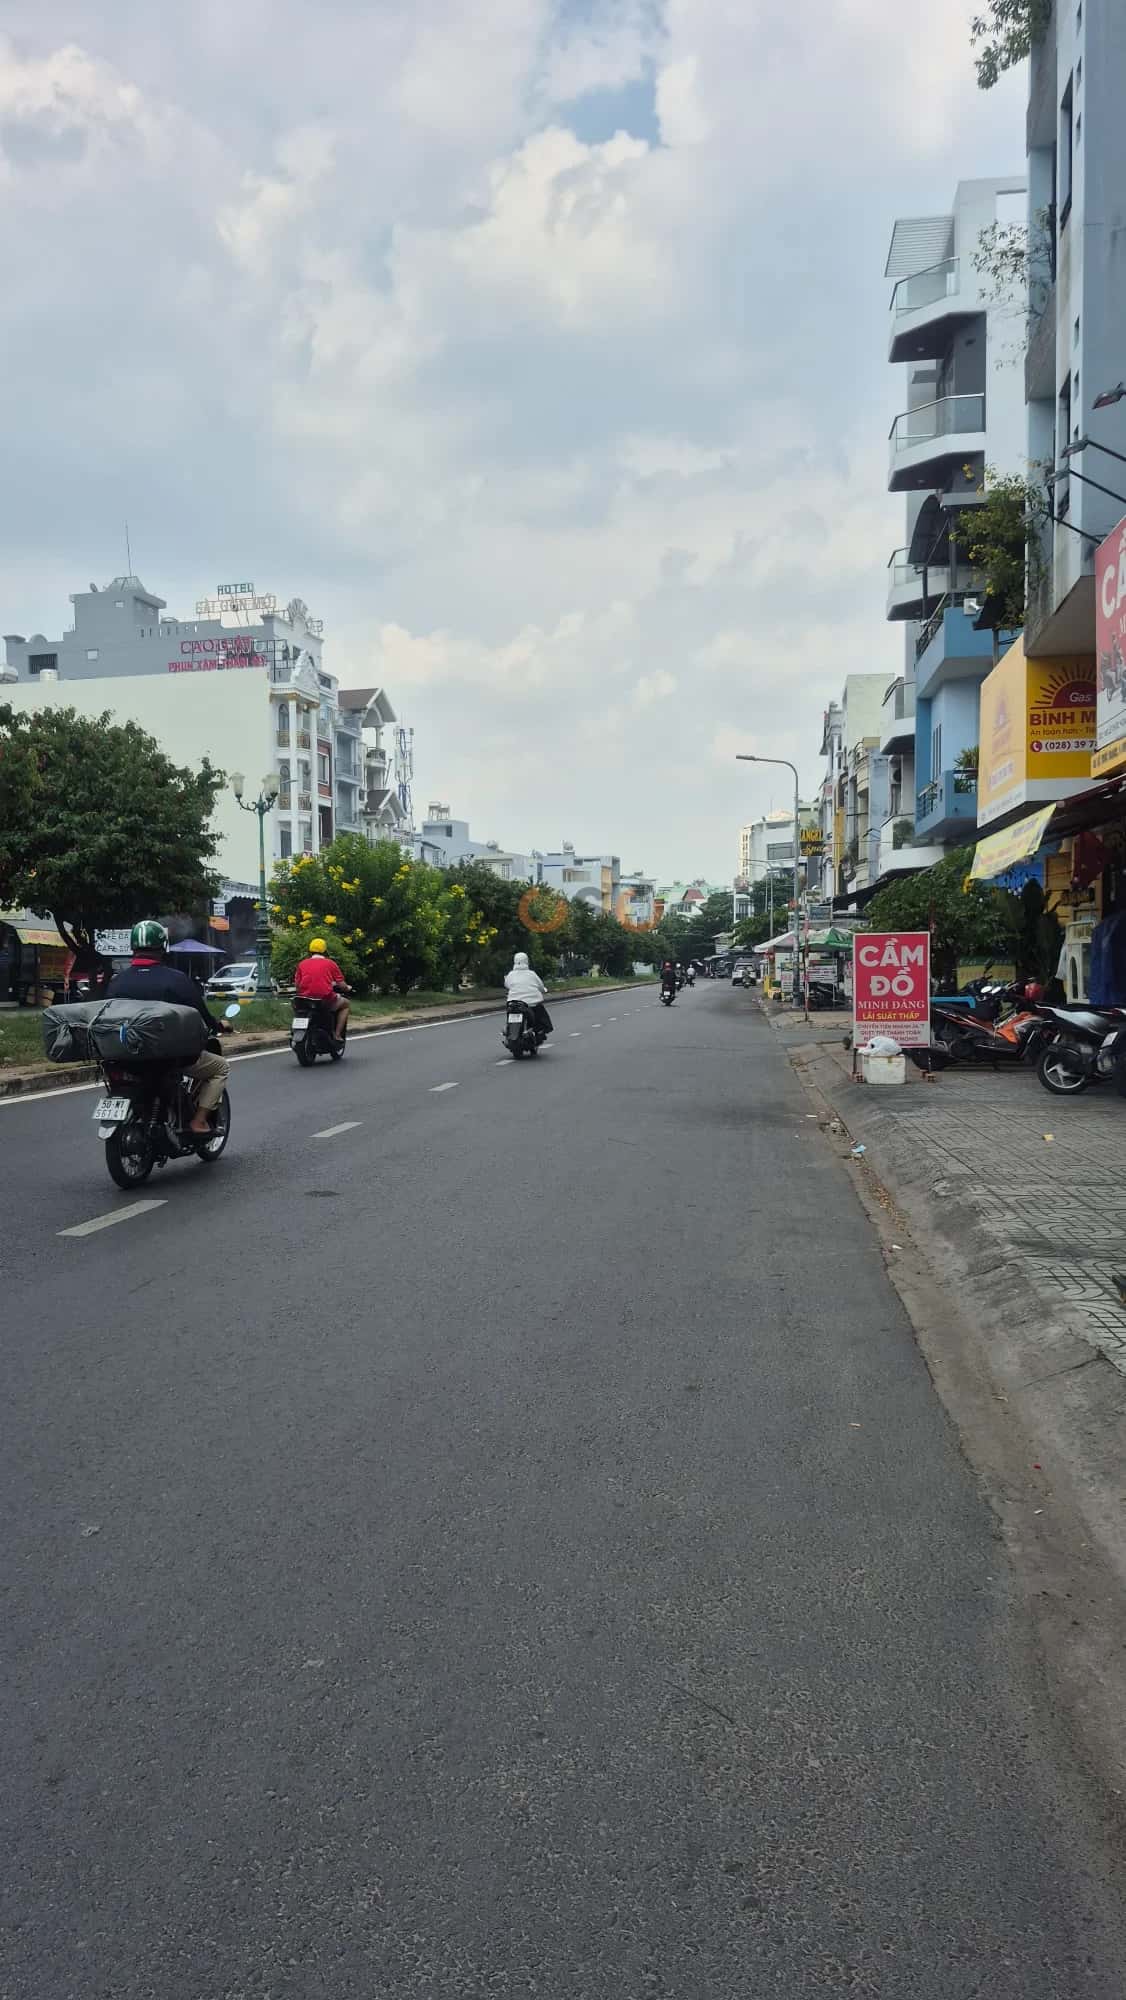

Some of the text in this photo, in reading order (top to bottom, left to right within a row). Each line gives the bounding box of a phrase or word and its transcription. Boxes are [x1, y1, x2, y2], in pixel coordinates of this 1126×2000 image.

[217, 583, 254, 595] HOTEL
[1069, 692, 1092, 703] Gas
[1031, 709, 1075, 726] BÌNH
[1045, 740, 1072, 751] (028)
[1074, 740, 1087, 749] 39
[859, 938, 924, 967] CẦM
[870, 966, 914, 997] ĐỒ
[858, 1001, 890, 1009] MINH
